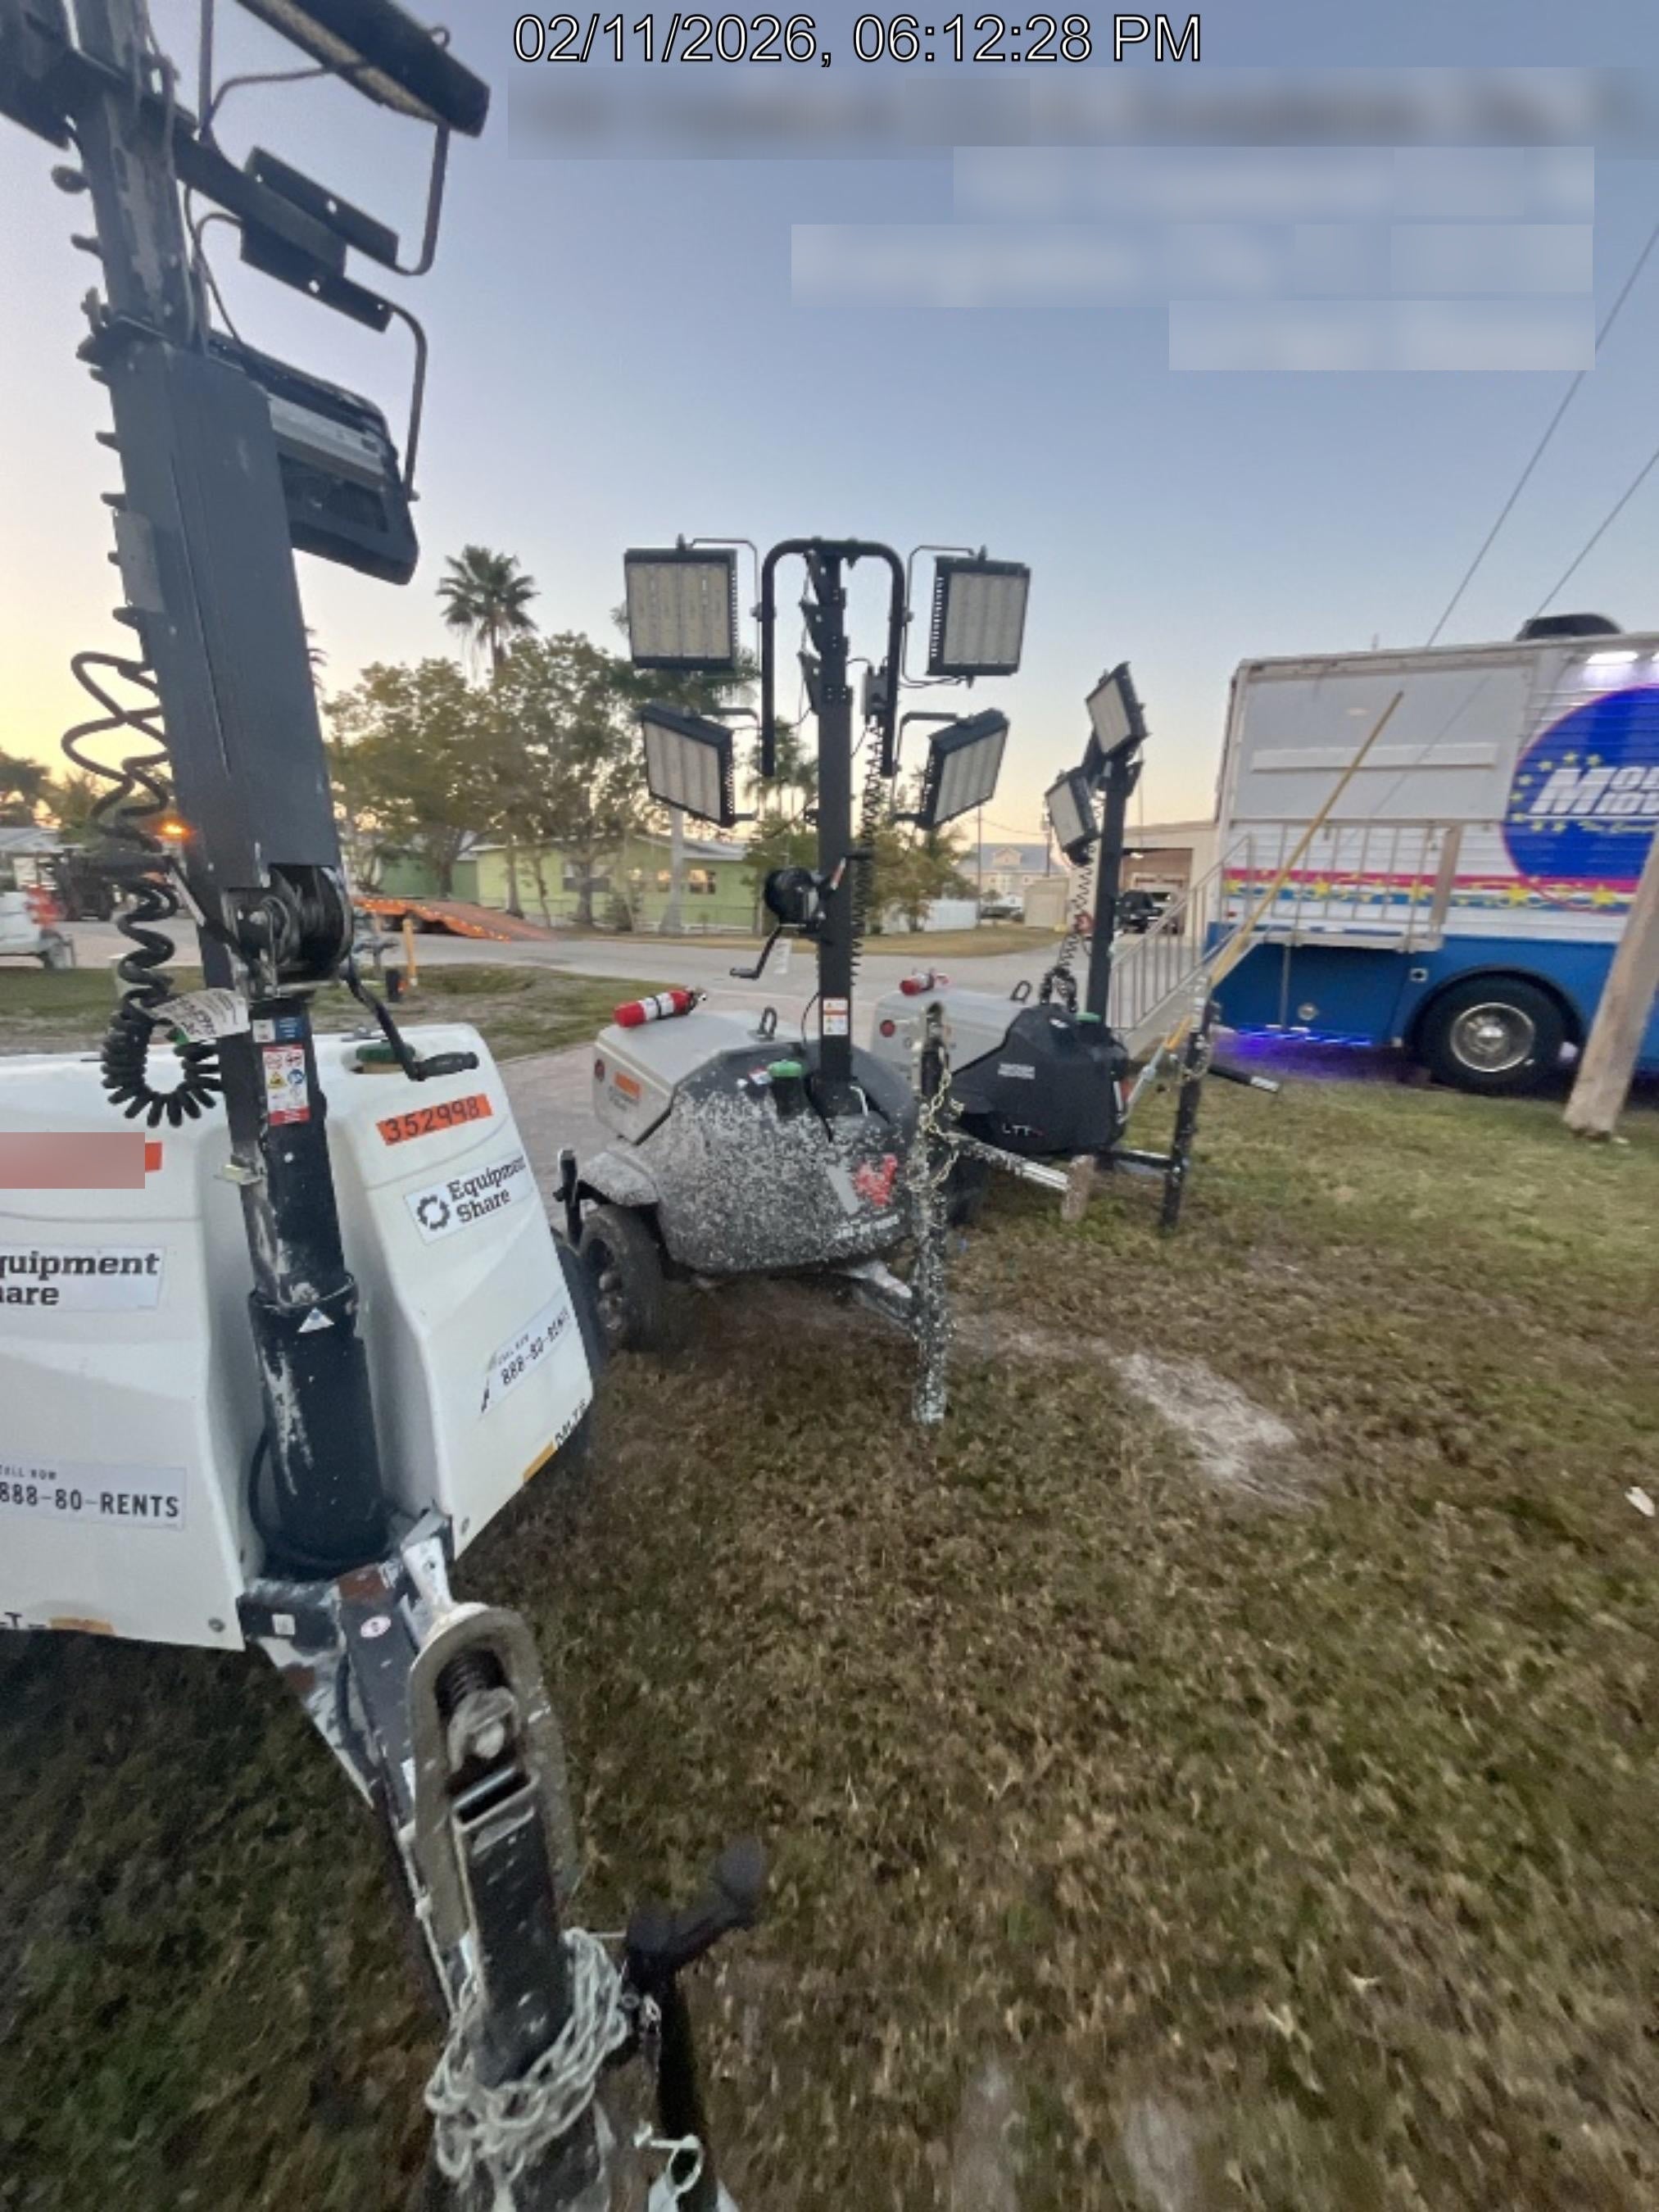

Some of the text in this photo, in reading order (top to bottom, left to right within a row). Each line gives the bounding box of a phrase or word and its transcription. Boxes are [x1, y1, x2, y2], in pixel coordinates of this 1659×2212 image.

[385, 1095, 481, 1143] 352998
[456, 1189, 511, 1223] Share
[0, 1285, 60, 1305] are
[0, 1480, 179, 1517] 888-80-RENTS
